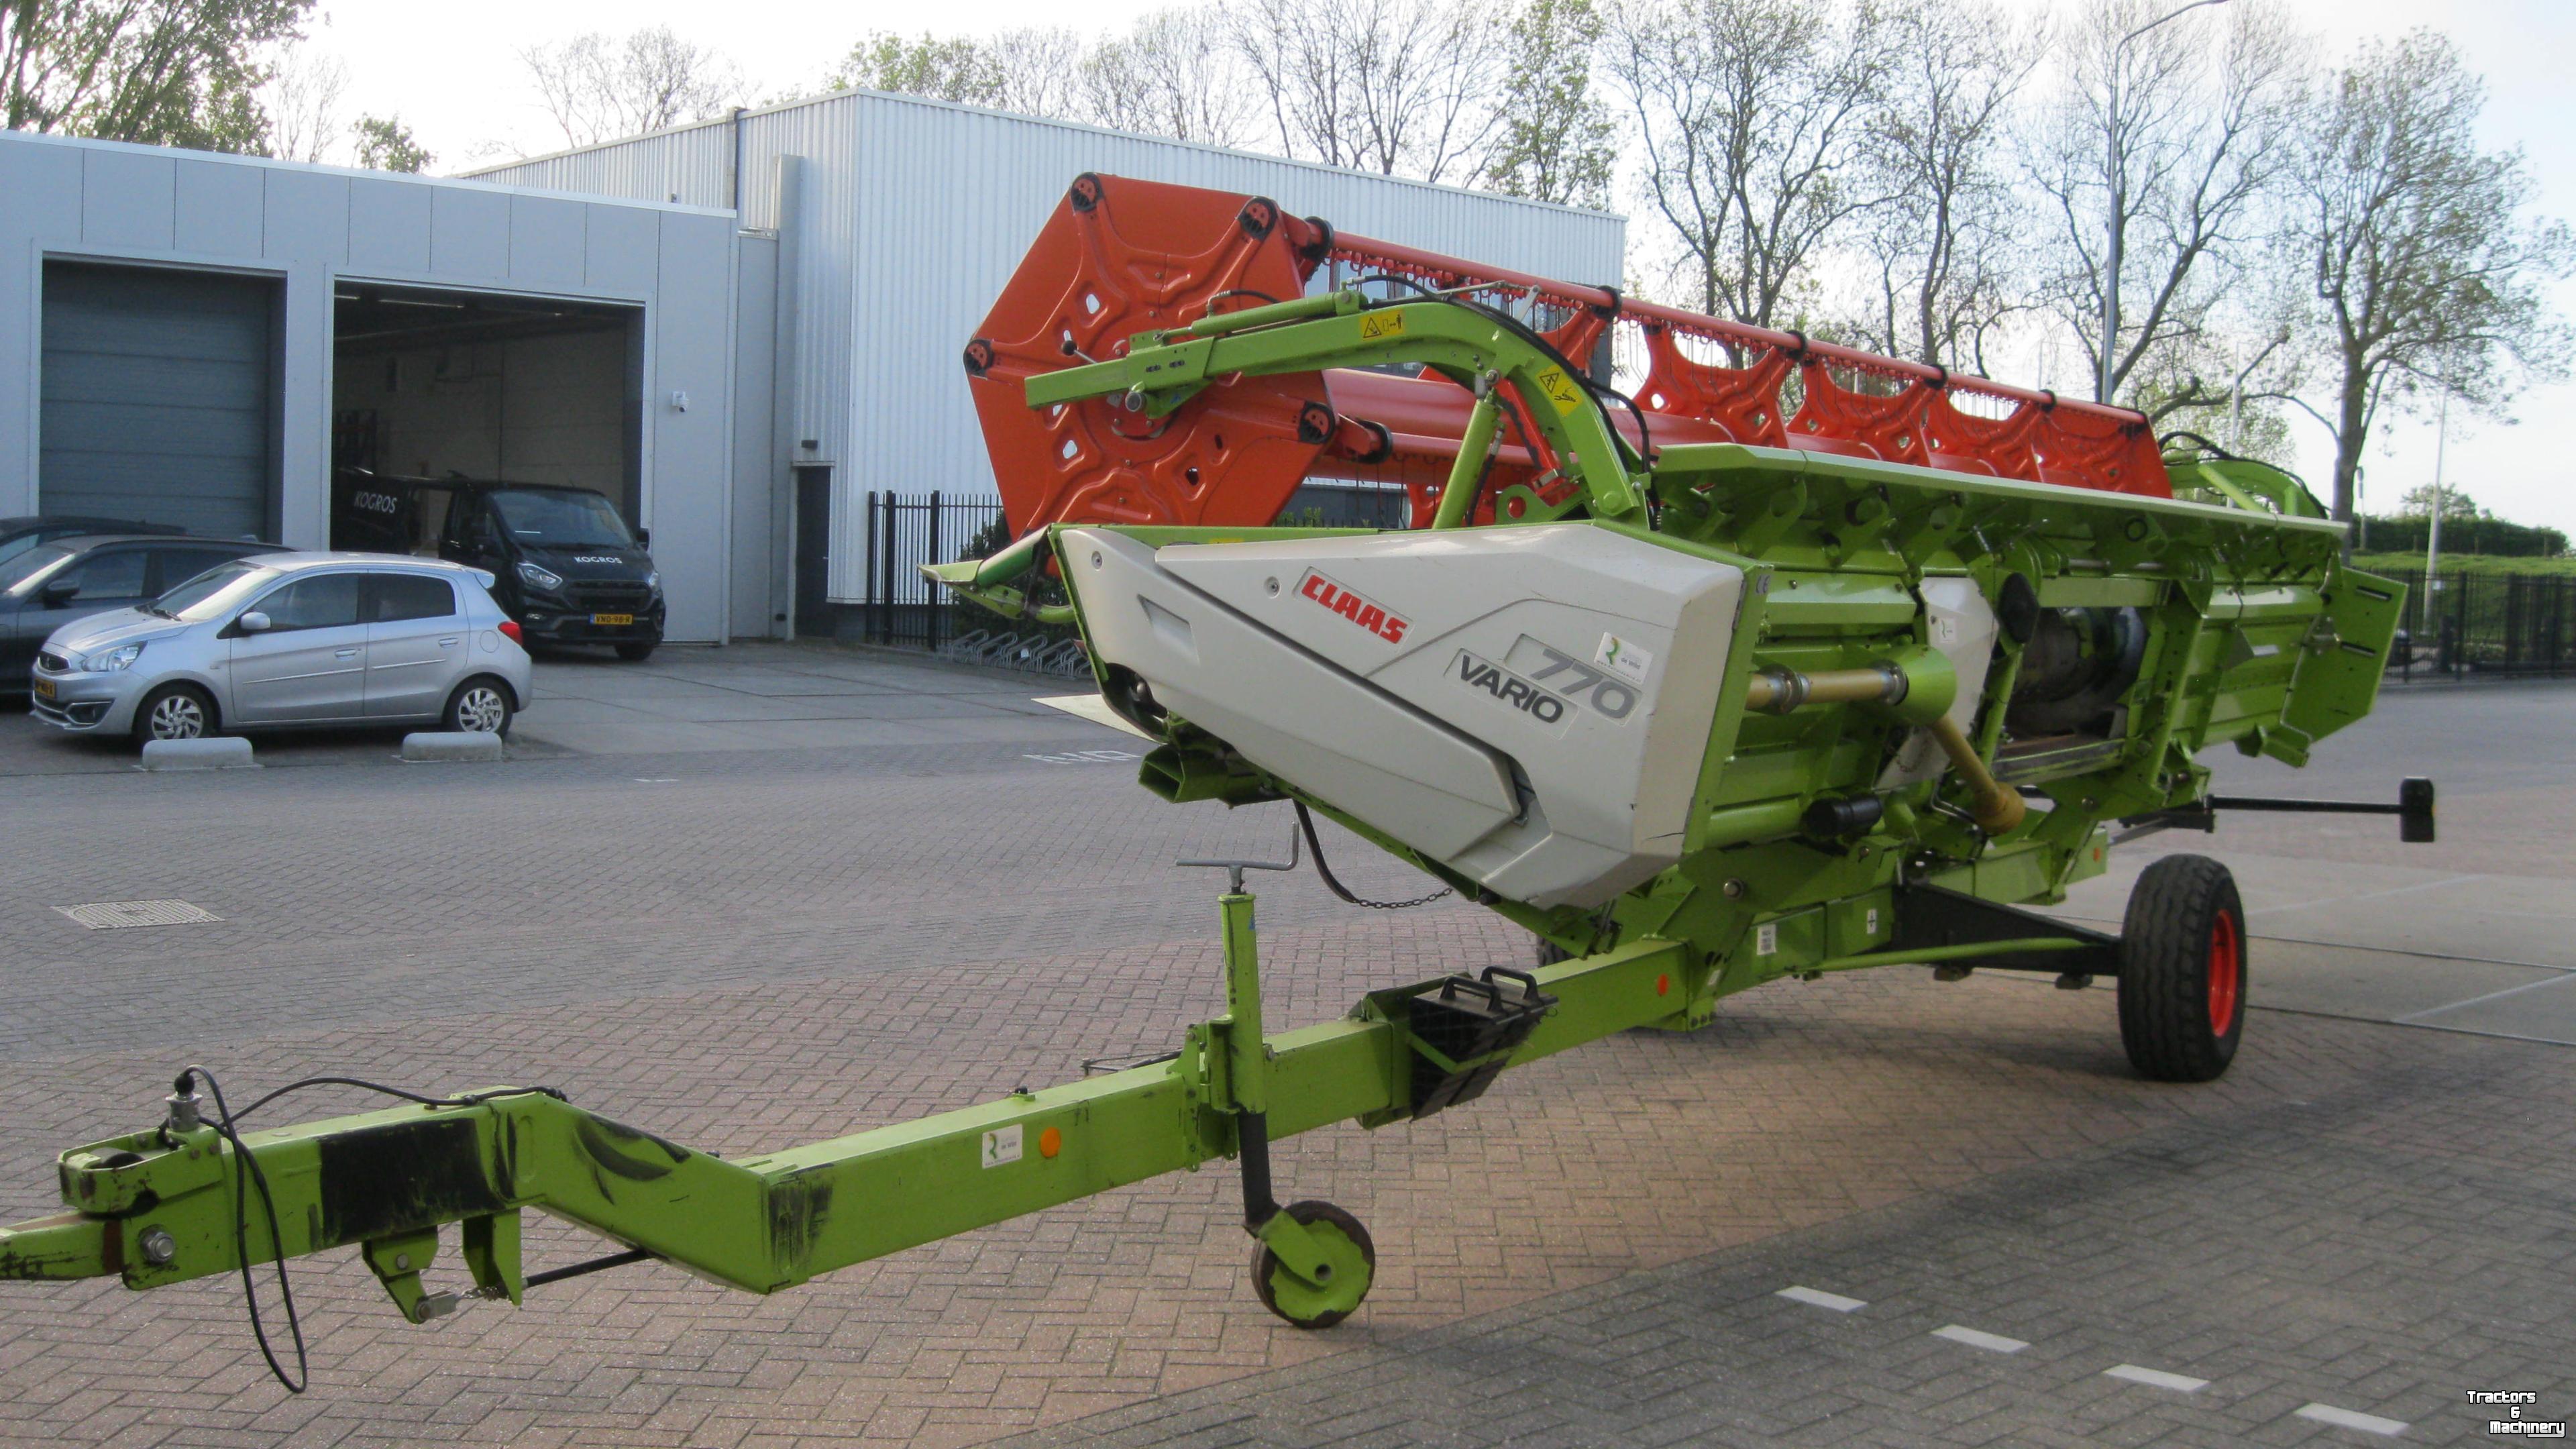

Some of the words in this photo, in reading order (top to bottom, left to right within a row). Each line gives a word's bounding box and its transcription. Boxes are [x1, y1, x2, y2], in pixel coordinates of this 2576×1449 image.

[354, 491, 398, 514] KOGROS
[574, 556, 623, 564] KOGROS
[1301, 574, 1407, 645] CLAAS
[1460, 654, 1564, 724] VARIO
[1529, 648, 1635, 719] 770
